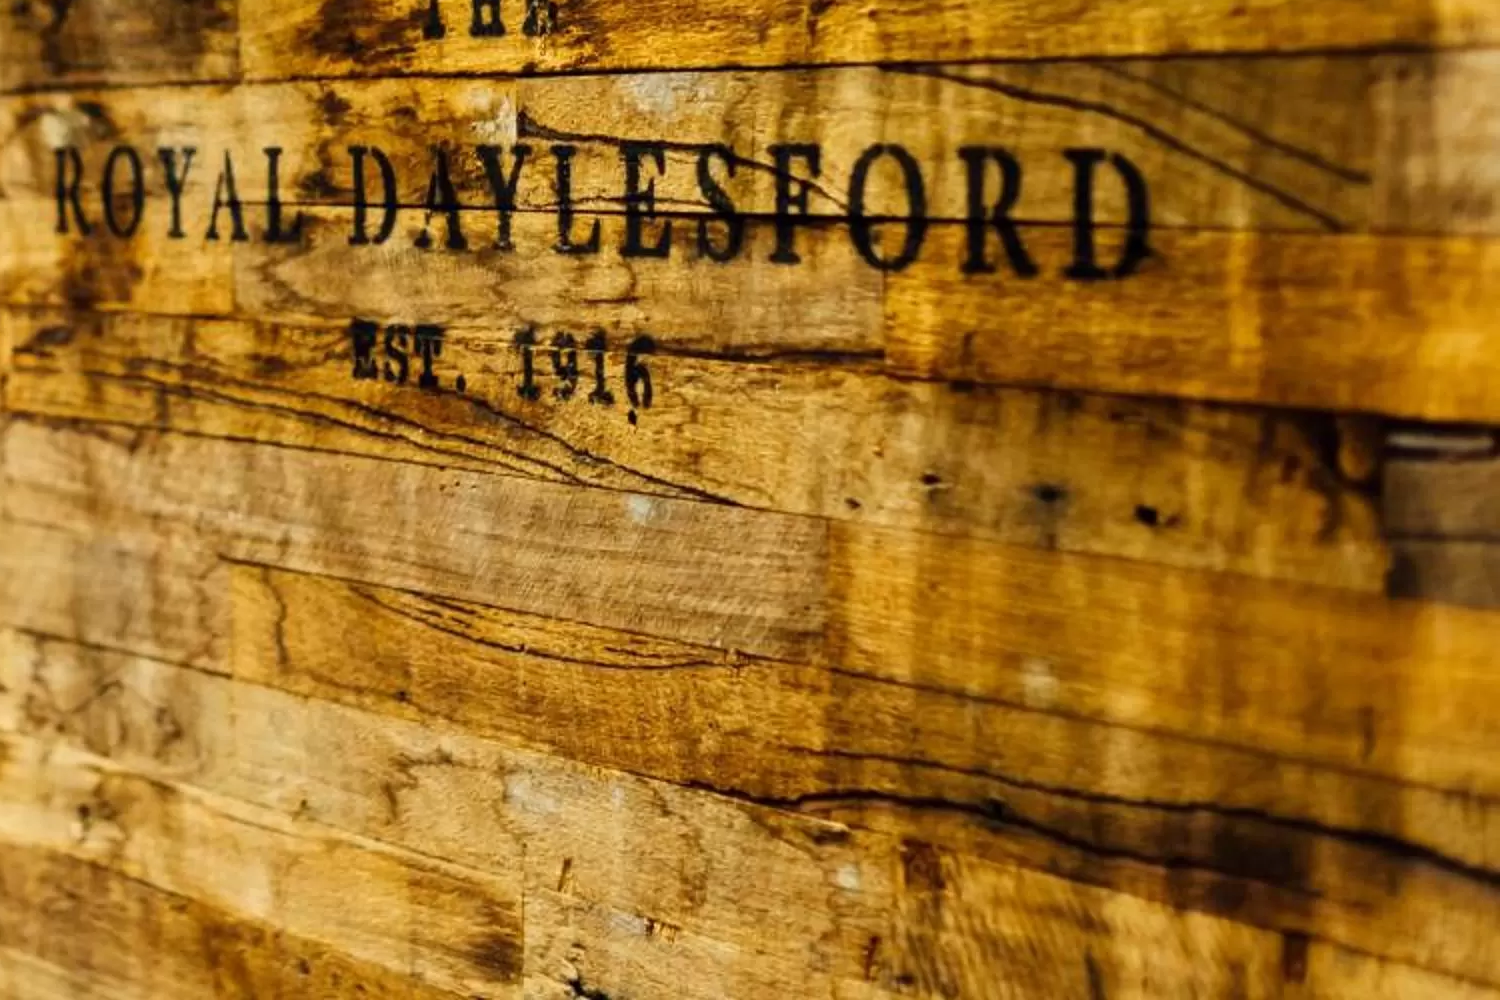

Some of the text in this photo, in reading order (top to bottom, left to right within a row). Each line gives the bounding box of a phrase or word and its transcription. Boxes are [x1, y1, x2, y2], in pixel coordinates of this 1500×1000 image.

[53, 142, 1156, 281] ROYAL DAYLESFORD
[350, 319, 654, 409] EST. 1916
